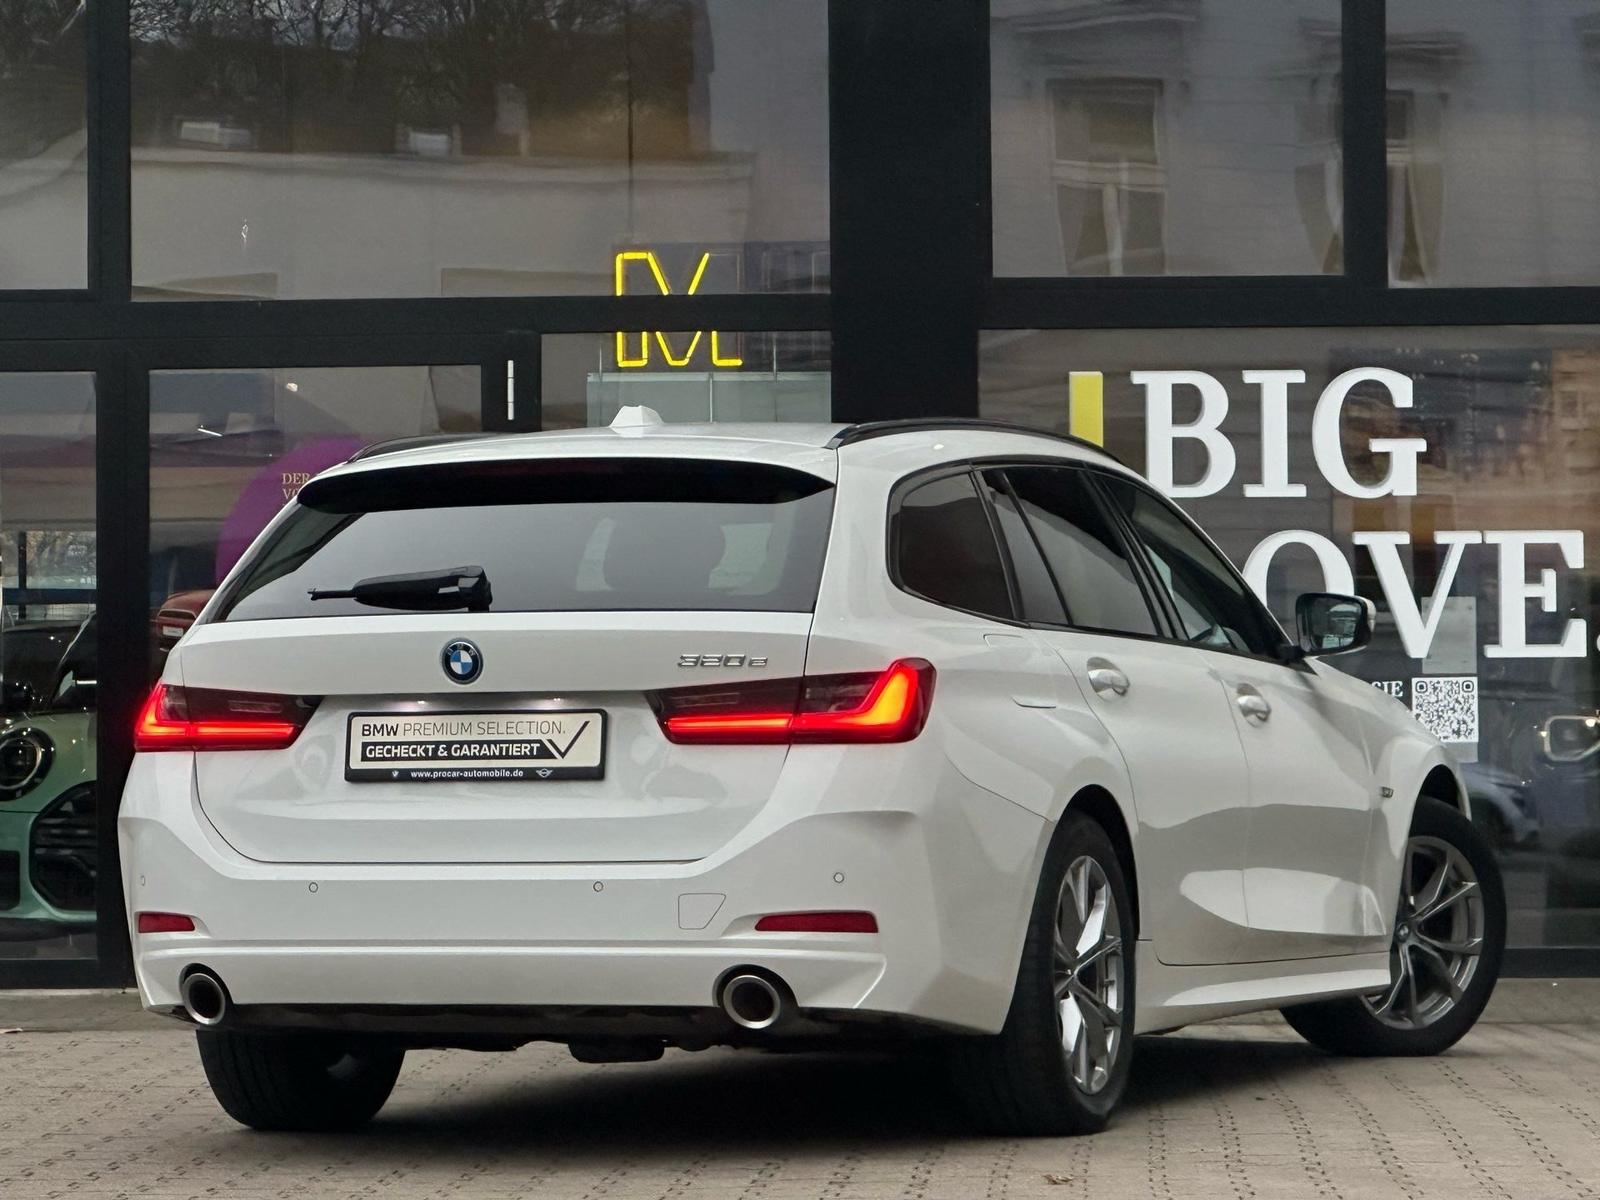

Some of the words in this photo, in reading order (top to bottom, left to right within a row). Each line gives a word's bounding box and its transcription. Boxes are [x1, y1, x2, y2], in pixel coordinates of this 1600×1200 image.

[1130, 367, 1427, 499] BIG
[1241, 529, 1600, 658] OVE
[678, 654, 768, 666] 320e
[361, 723, 399, 736] BMW
[403, 722, 472, 736] PREMIUM
[477, 721, 566, 735] SELECTION.
[366, 745, 435, 758] GECHECKT
[437, 744, 448, 757] &
[451, 743, 540, 756] GARANTIERT
[411, 768, 524, 779] www.procar-automobile.de
